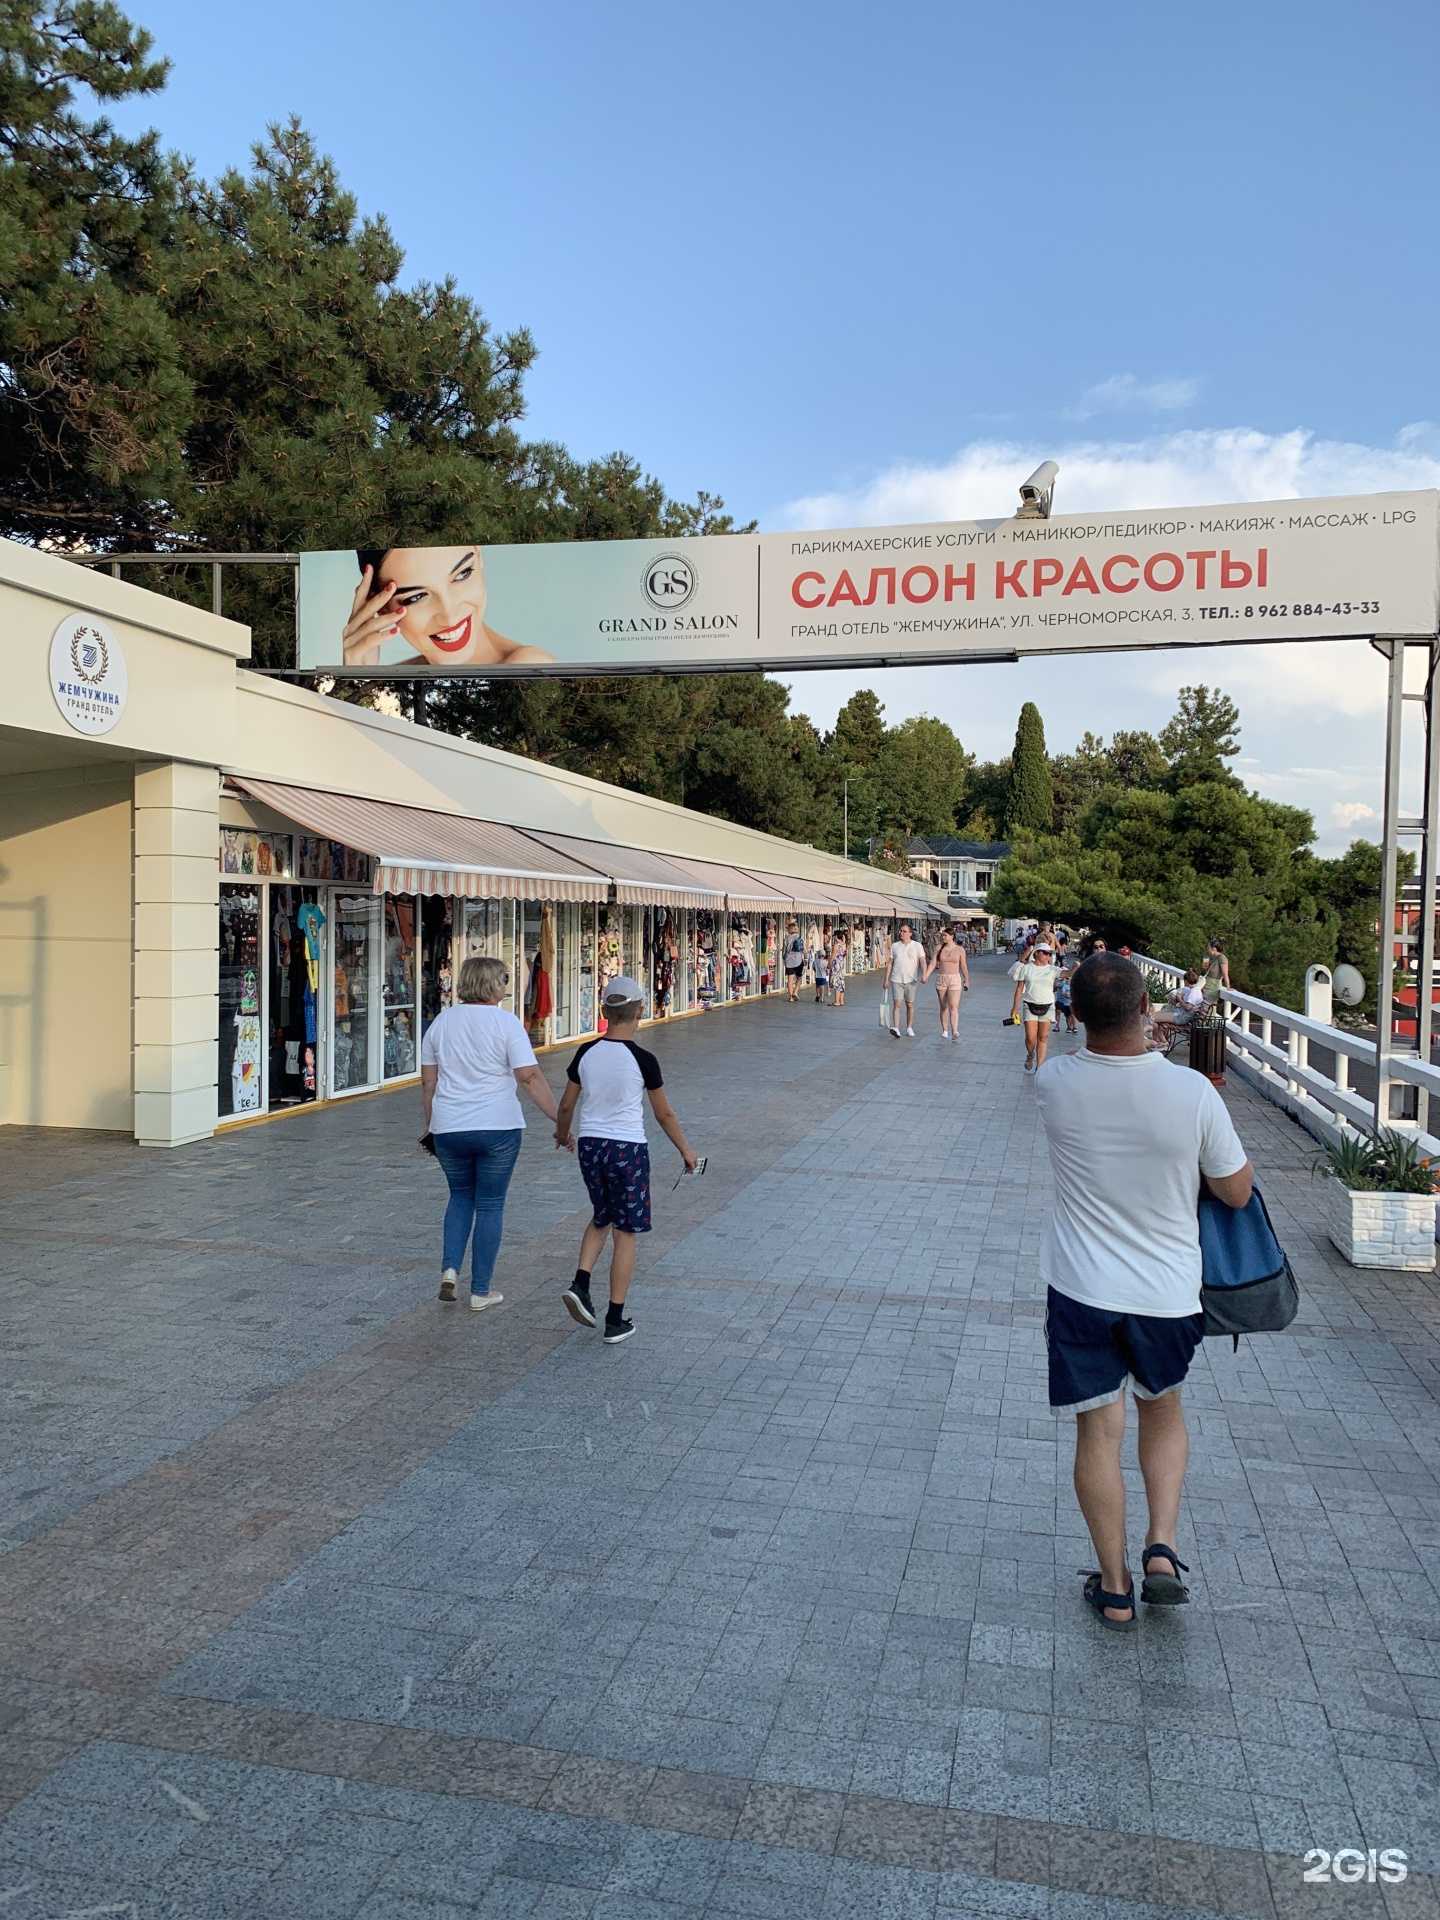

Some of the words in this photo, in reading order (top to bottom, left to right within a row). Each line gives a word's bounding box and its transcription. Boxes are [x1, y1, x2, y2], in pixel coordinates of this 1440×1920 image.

[791, 535, 932, 555] ПАРИКМАХЕРСКИЕ
[936, 531, 996, 548] УСЛУГИ
[1012, 521, 1188, 543] МАНИКЮР/ПЕДИКЮР
[1199, 516, 1276, 533] МАКИЯЖ
[1288, 512, 1369, 529] МАССАЖ
[1383, 510, 1417, 525] LPG
[648, 569, 689, 597] GS
[791, 562, 976, 609] САЛОН
[995, 548, 1268, 599] КРАСОТЫ
[598, 617, 667, 633] GRAND
[673, 613, 739, 631] SALON
[791, 623, 838, 637] ГРАНД
[841, 621, 890, 636] ОТЕЛЬ
[1010, 614, 1034, 628] УЛ.
[1199, 606, 1240, 620] ТЕЛ.:
[1244, 605, 1254, 618] 8
[1258, 604, 1288, 618] 962
[1292, 600, 1380, 616] 884-43-33
[58, 681, 120, 706] ЖЕМЧУЖИНА
[67, 698, 91, 712] ГРАНД
[92, 703, 114, 716] ОТЕЛЬ
